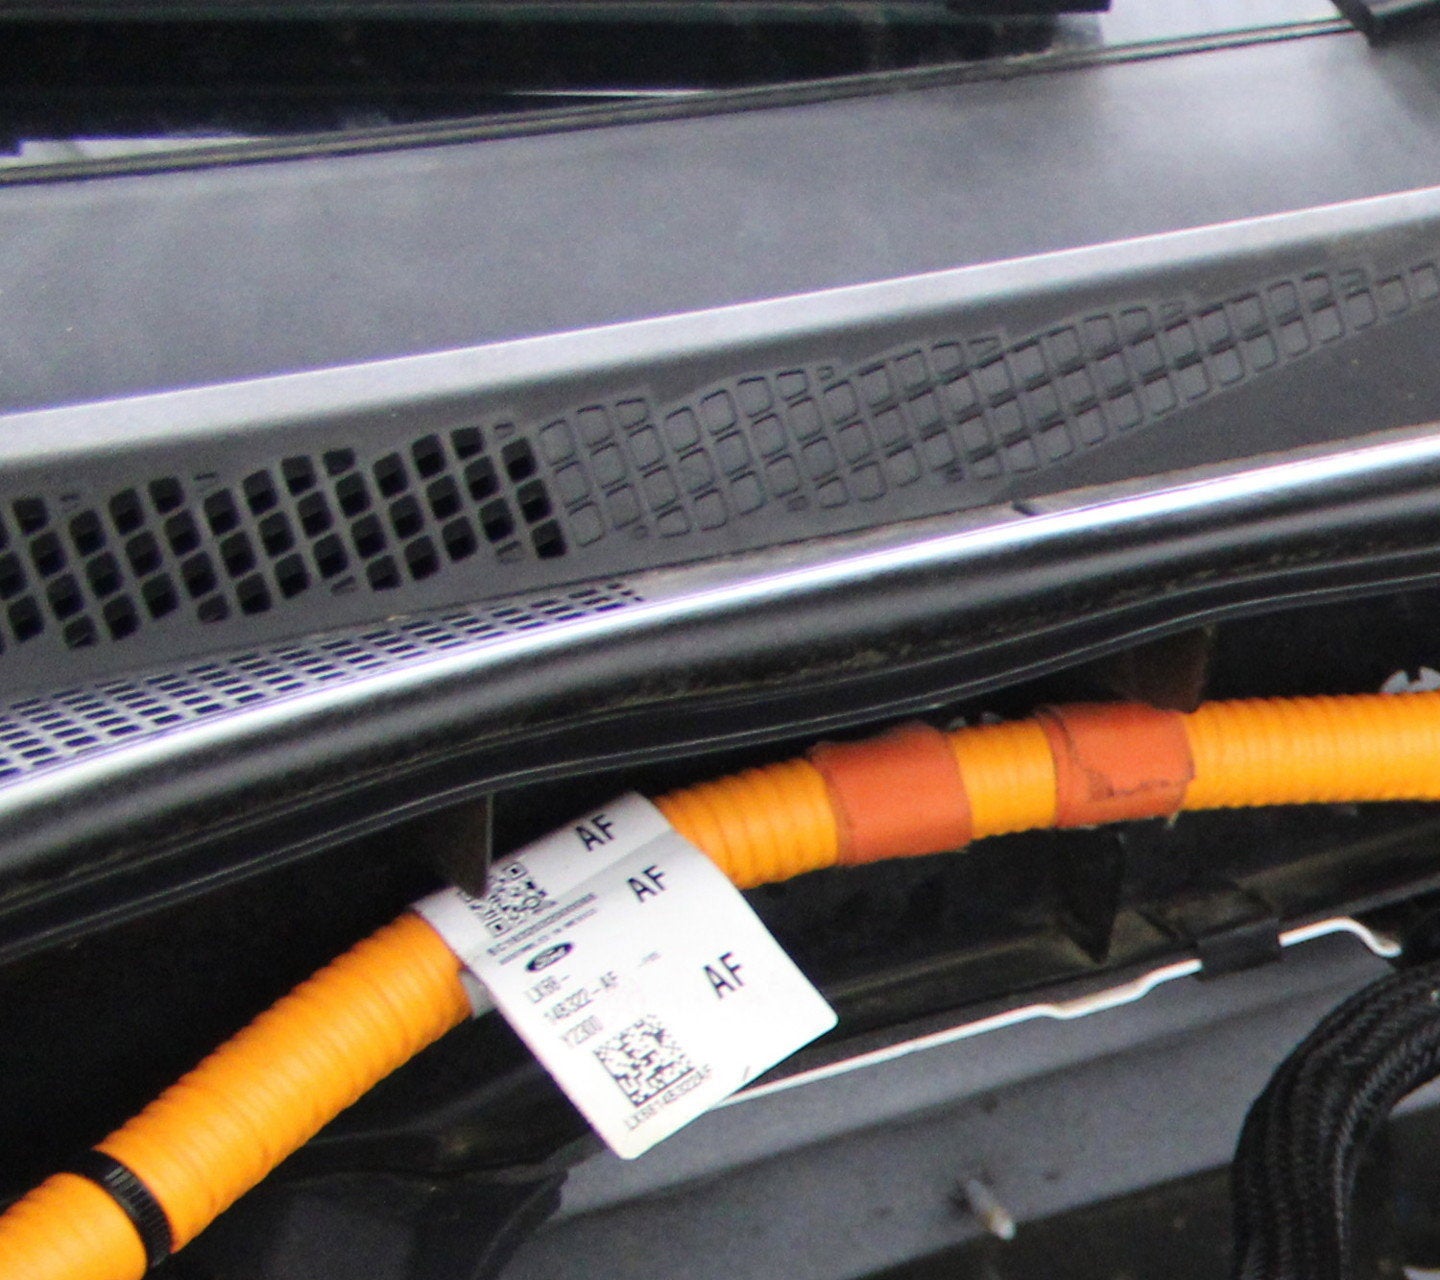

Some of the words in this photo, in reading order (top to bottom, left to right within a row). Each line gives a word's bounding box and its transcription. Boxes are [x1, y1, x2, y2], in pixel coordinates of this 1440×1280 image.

[575, 814, 615, 852] AF
[626, 865, 666, 903] AF
[703, 952, 744, 999] AF
